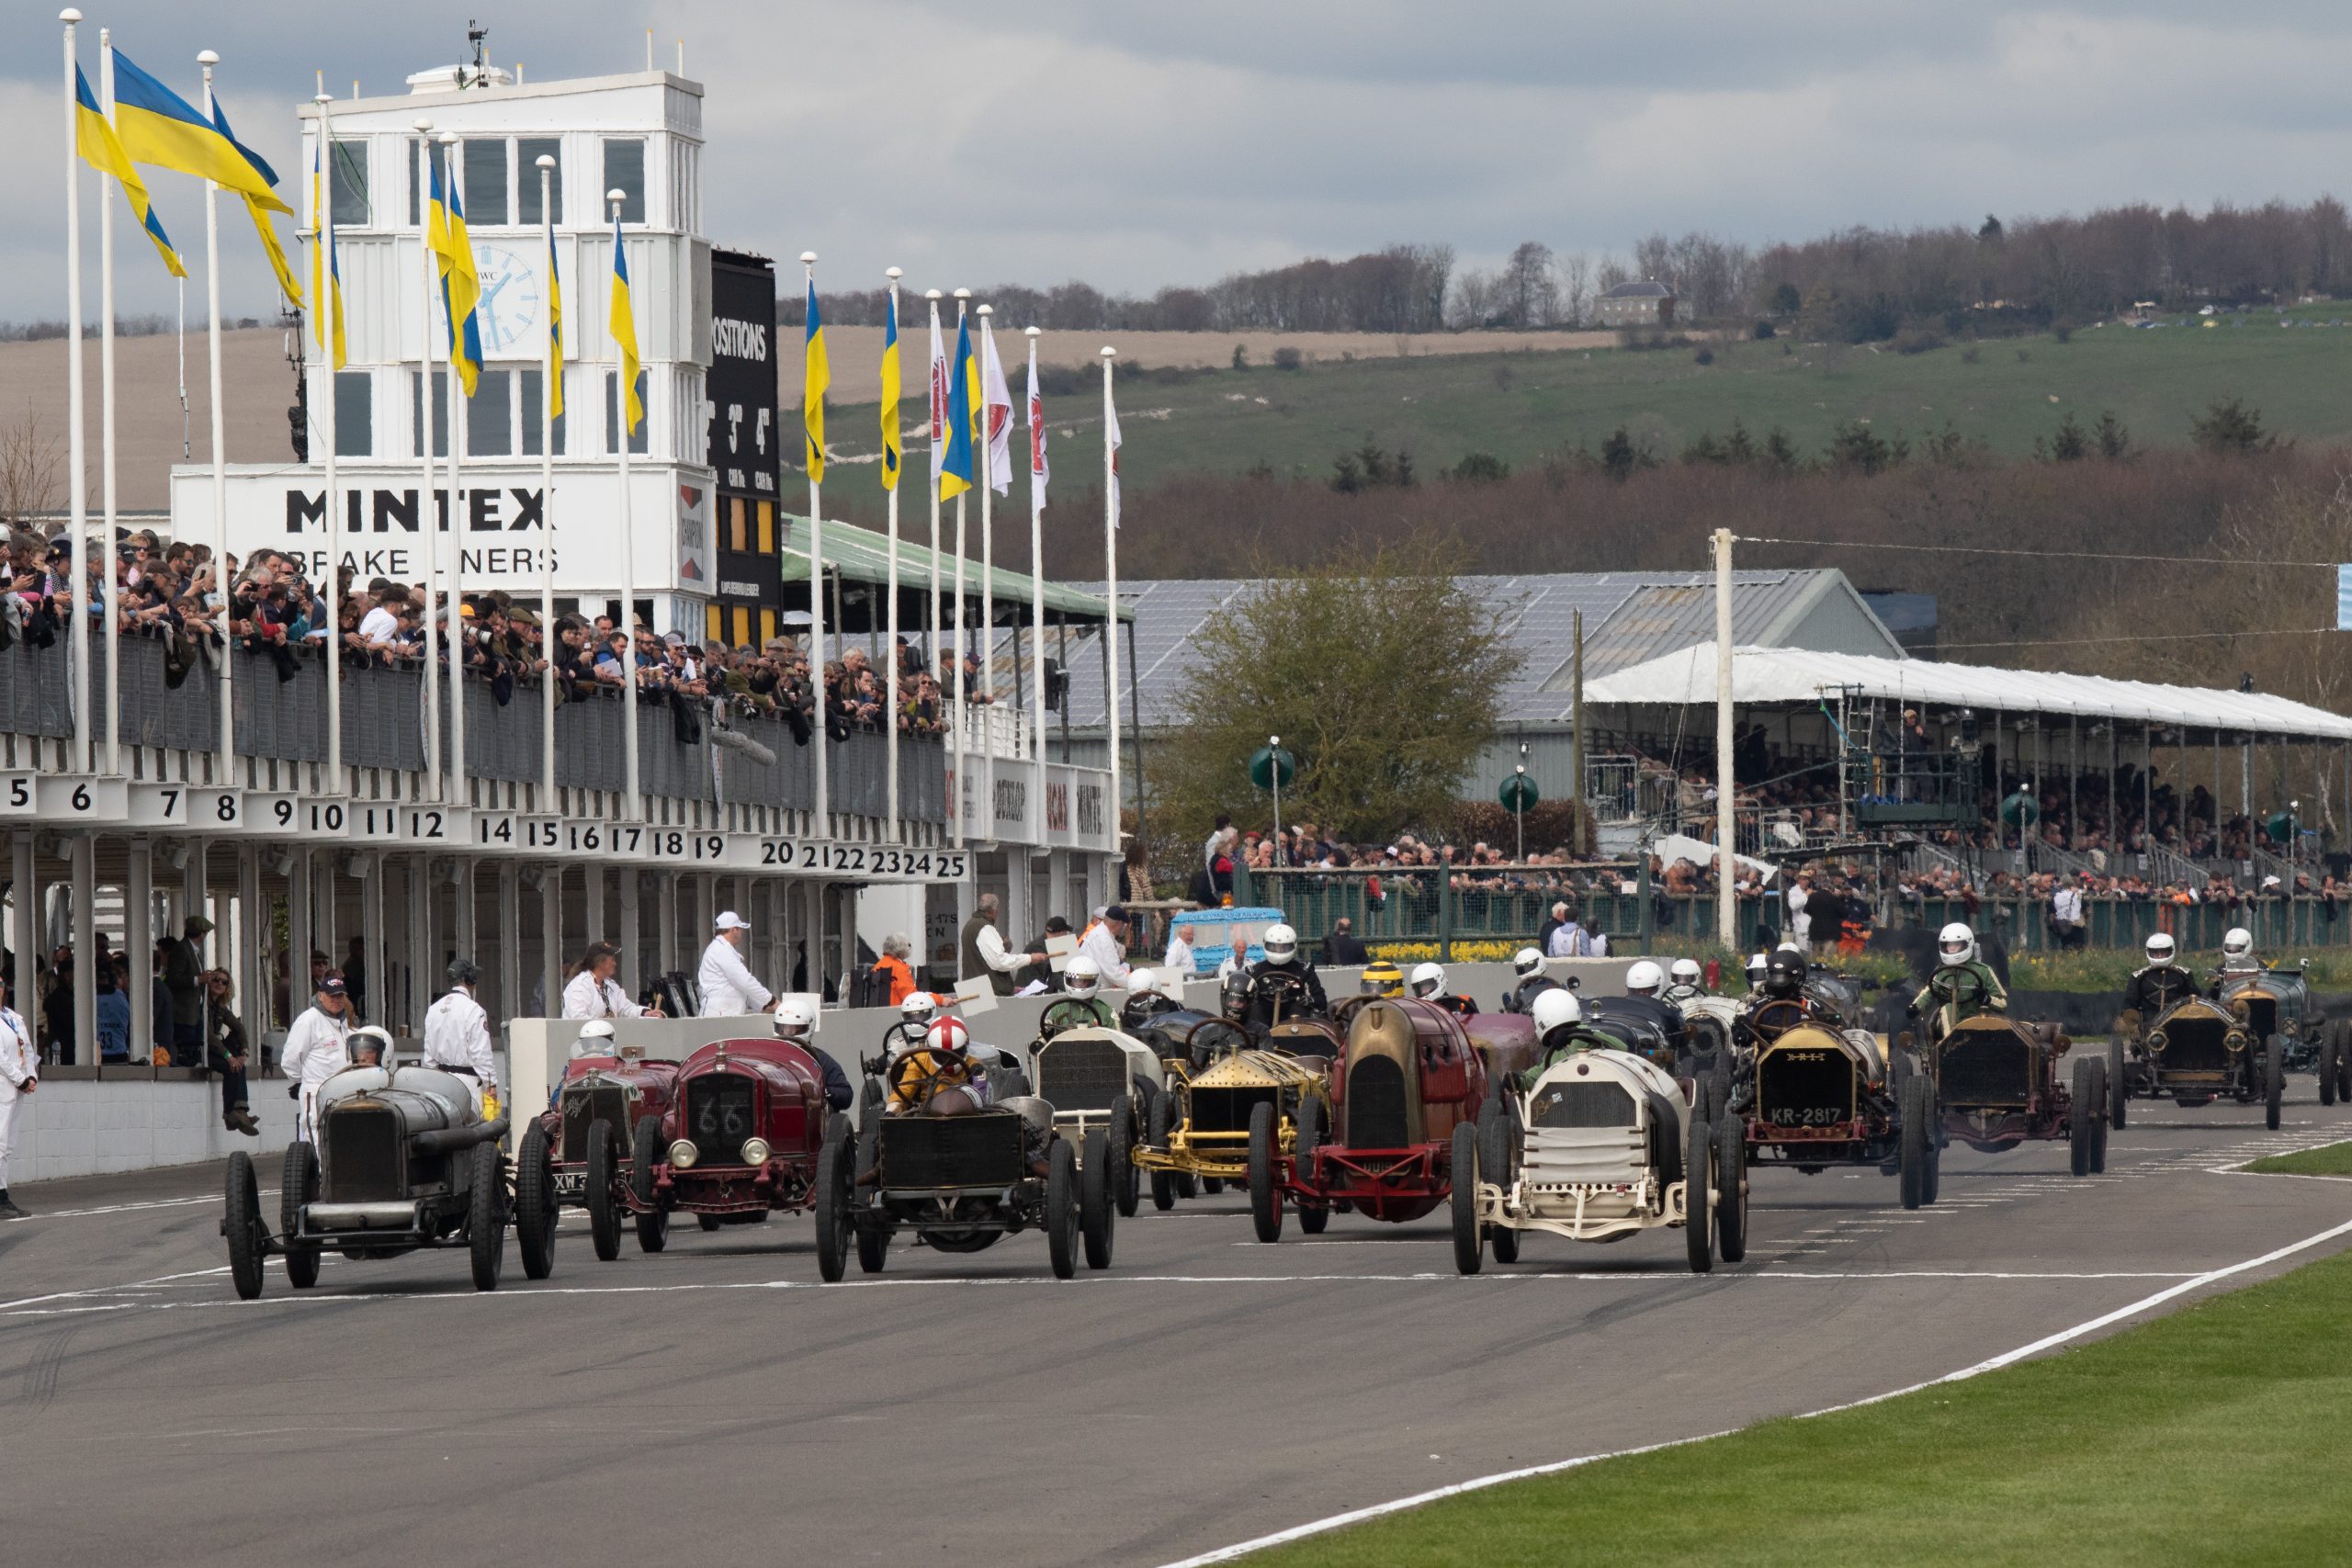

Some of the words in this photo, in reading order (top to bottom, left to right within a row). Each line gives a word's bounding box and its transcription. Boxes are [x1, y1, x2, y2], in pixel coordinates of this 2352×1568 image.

[713, 316, 766, 362] OSITIONS
[287, 489, 557, 533] MINTEX
[435, 548, 559, 574] NERS
[10, 778, 28, 807] 5
[72, 783, 91, 811] 6
[160, 790, 179, 818] 7
[217, 795, 236, 822] 8
[274, 799, 292, 827] 9
[311, 804, 343, 830] 10
[1046, 783, 1069, 831] UCAS
[367, 808, 394, 835] 11
[412, 812, 443, 838] 12
[481, 817, 512, 843] 14
[528, 822, 558, 847] 15
[569, 826, 600, 851] 16
[612, 828, 641, 852] 17
[654, 832, 684, 856] 18
[695, 836, 724, 860] 19
[762, 841, 795, 865] 20
[802, 845, 830, 868] 21
[834, 848, 864, 870] 22
[871, 851, 901, 874] 23
[903, 853, 931, 875] 24
[936, 856, 964, 878] 25
[554, 1175, 575, 1190] XW
